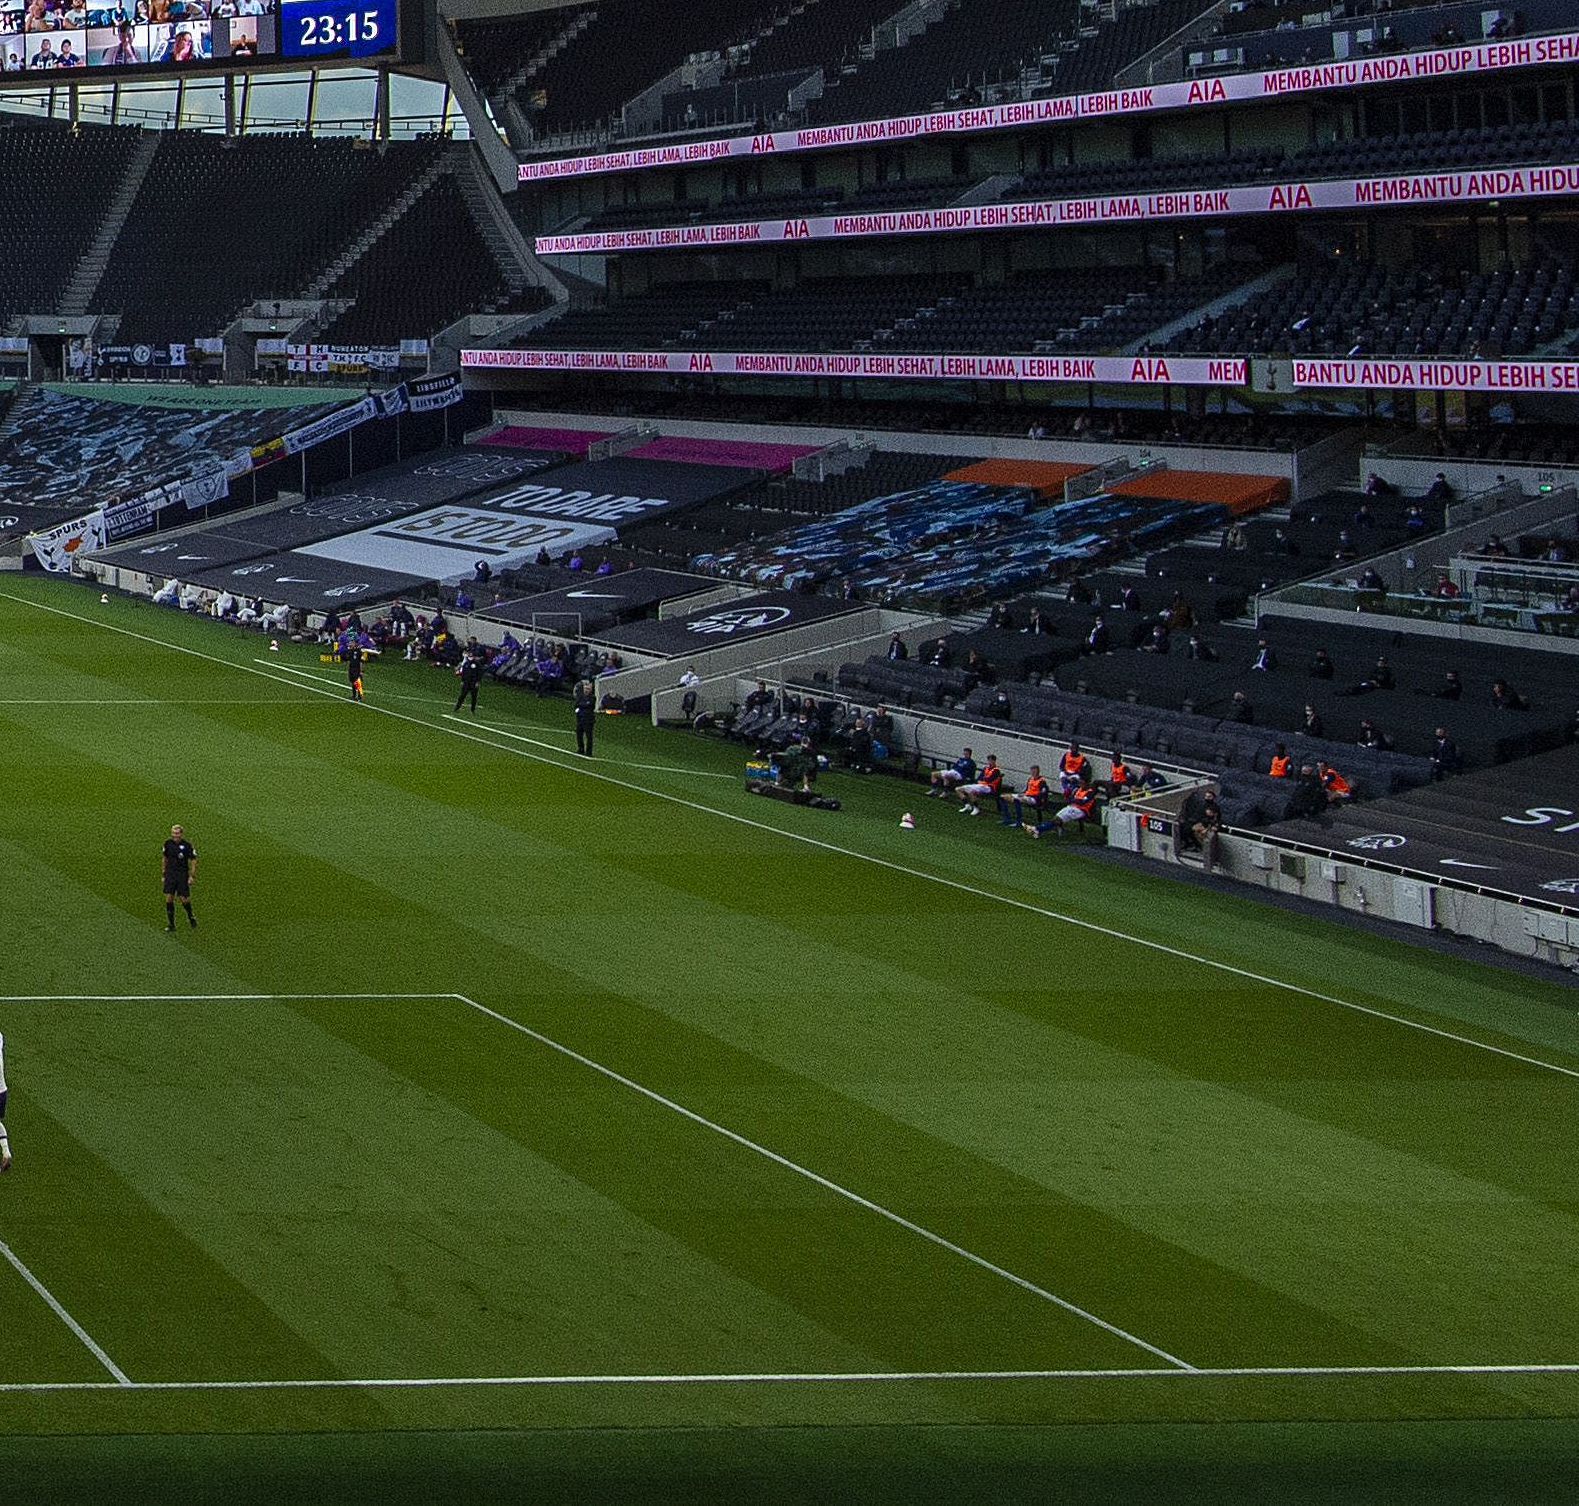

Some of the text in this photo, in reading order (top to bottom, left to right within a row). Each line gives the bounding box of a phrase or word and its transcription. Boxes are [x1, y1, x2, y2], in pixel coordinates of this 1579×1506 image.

[300, 11, 379, 46] 23:15
[1263, 64, 1357, 93] MEMBANTU
[1361, 59, 1411, 80] ANDA
[1415, 51, 1472, 75] HIDUP
[1476, 45, 1531, 70] LEBIH
[1188, 79, 1226, 104] AIA
[797, 91, 1152, 146] MEMBANTU ANDA HIDUP LEBIH SEHAT, LEBIH LAMA, LEBIH BAIK
[751, 136, 775, 153] AIA
[1269, 186, 1312, 209] AIA
[1355, 177, 1462, 203] MEMBANTU
[1467, 173, 1524, 195] ANDA
[689, 355, 712, 372] AIA
[736, 357, 1095, 379] MEMBANTU ANDA HIDUP LEBIH SEHAT, LEBIH LAMA, LEBIH BAIK
[1130, 359, 1171, 383] AIA
[1361, 365, 1414, 386] ANDA
[1419, 365, 1481, 388] HIDUP
[1486, 366, 1545, 389] LEBIH
[1551, 367, 1579, 389] SE
[49, 519, 88, 540] SPURS
